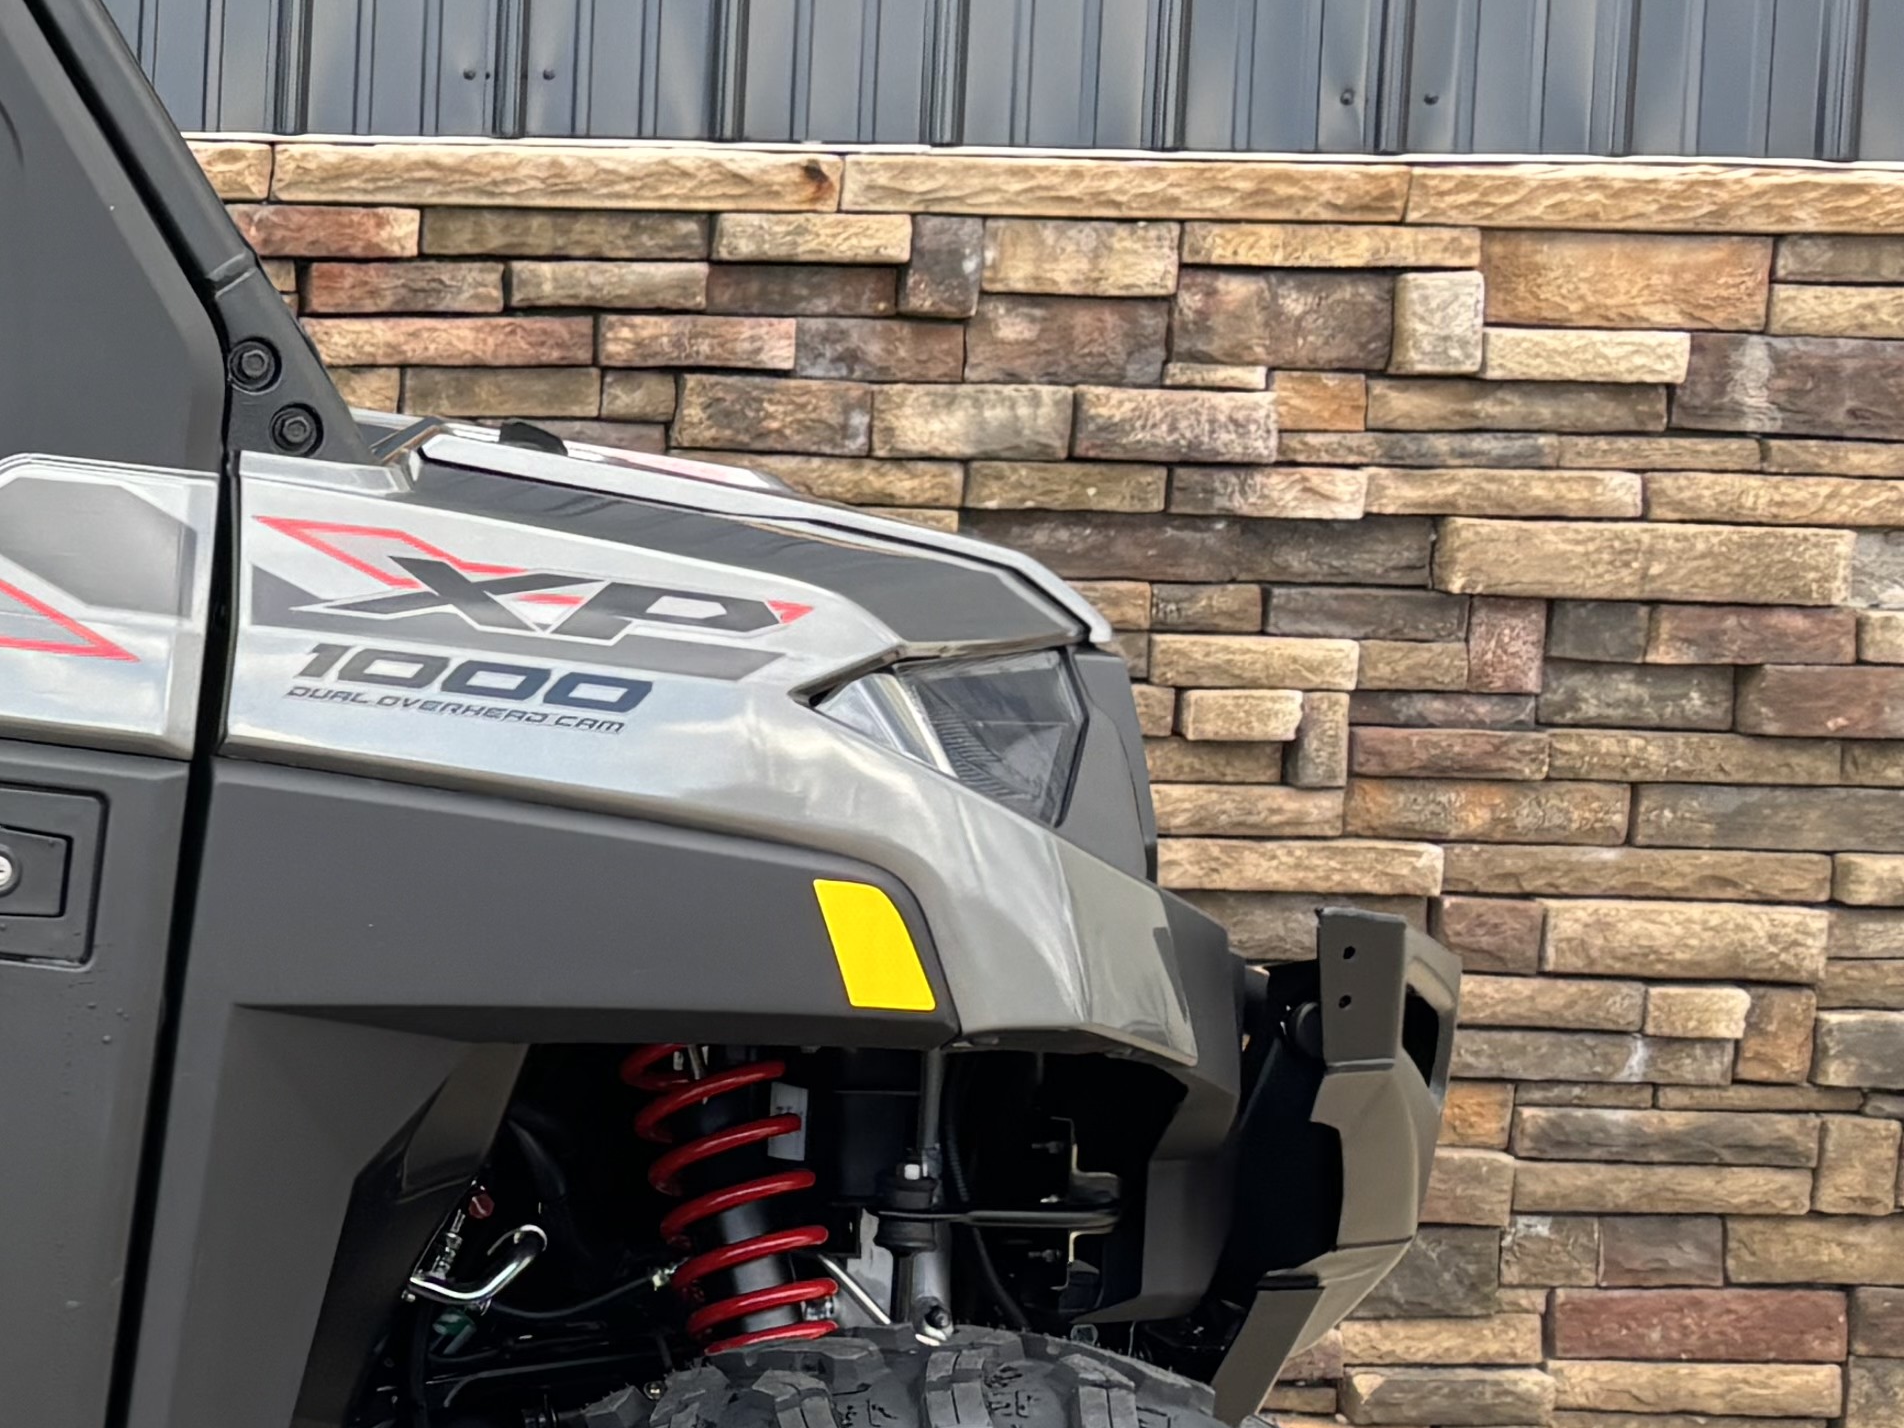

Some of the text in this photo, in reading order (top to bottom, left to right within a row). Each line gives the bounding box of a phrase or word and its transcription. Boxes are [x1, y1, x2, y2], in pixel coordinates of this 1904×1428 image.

[317, 554, 784, 642] XP
[286, 686, 625, 733] DUAL OVERHEAD CAM
[295, 643, 655, 712] 1000
